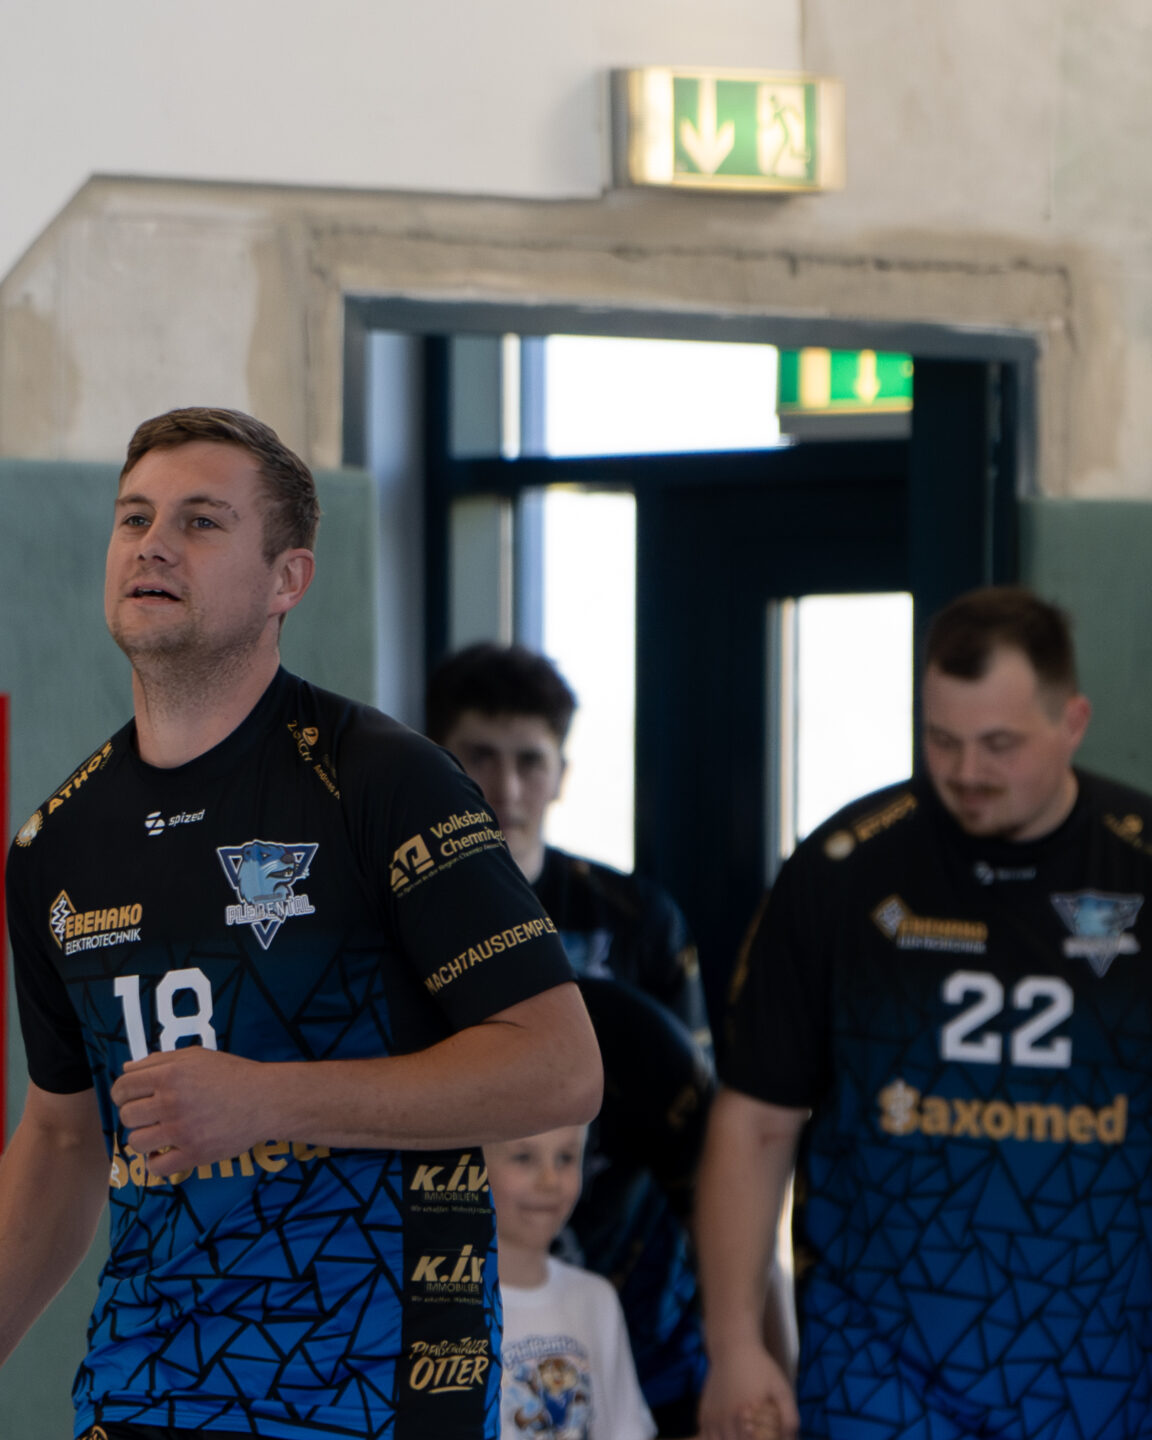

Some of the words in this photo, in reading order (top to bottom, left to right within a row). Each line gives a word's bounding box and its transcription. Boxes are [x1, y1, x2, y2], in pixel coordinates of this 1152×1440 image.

[168, 808, 206, 827] spized
[65, 902, 143, 940] EBEHAKO
[114, 967, 217, 1062] 18
[940, 970, 1074, 1068] 22
[409, 1355, 489, 1391] OTTER
